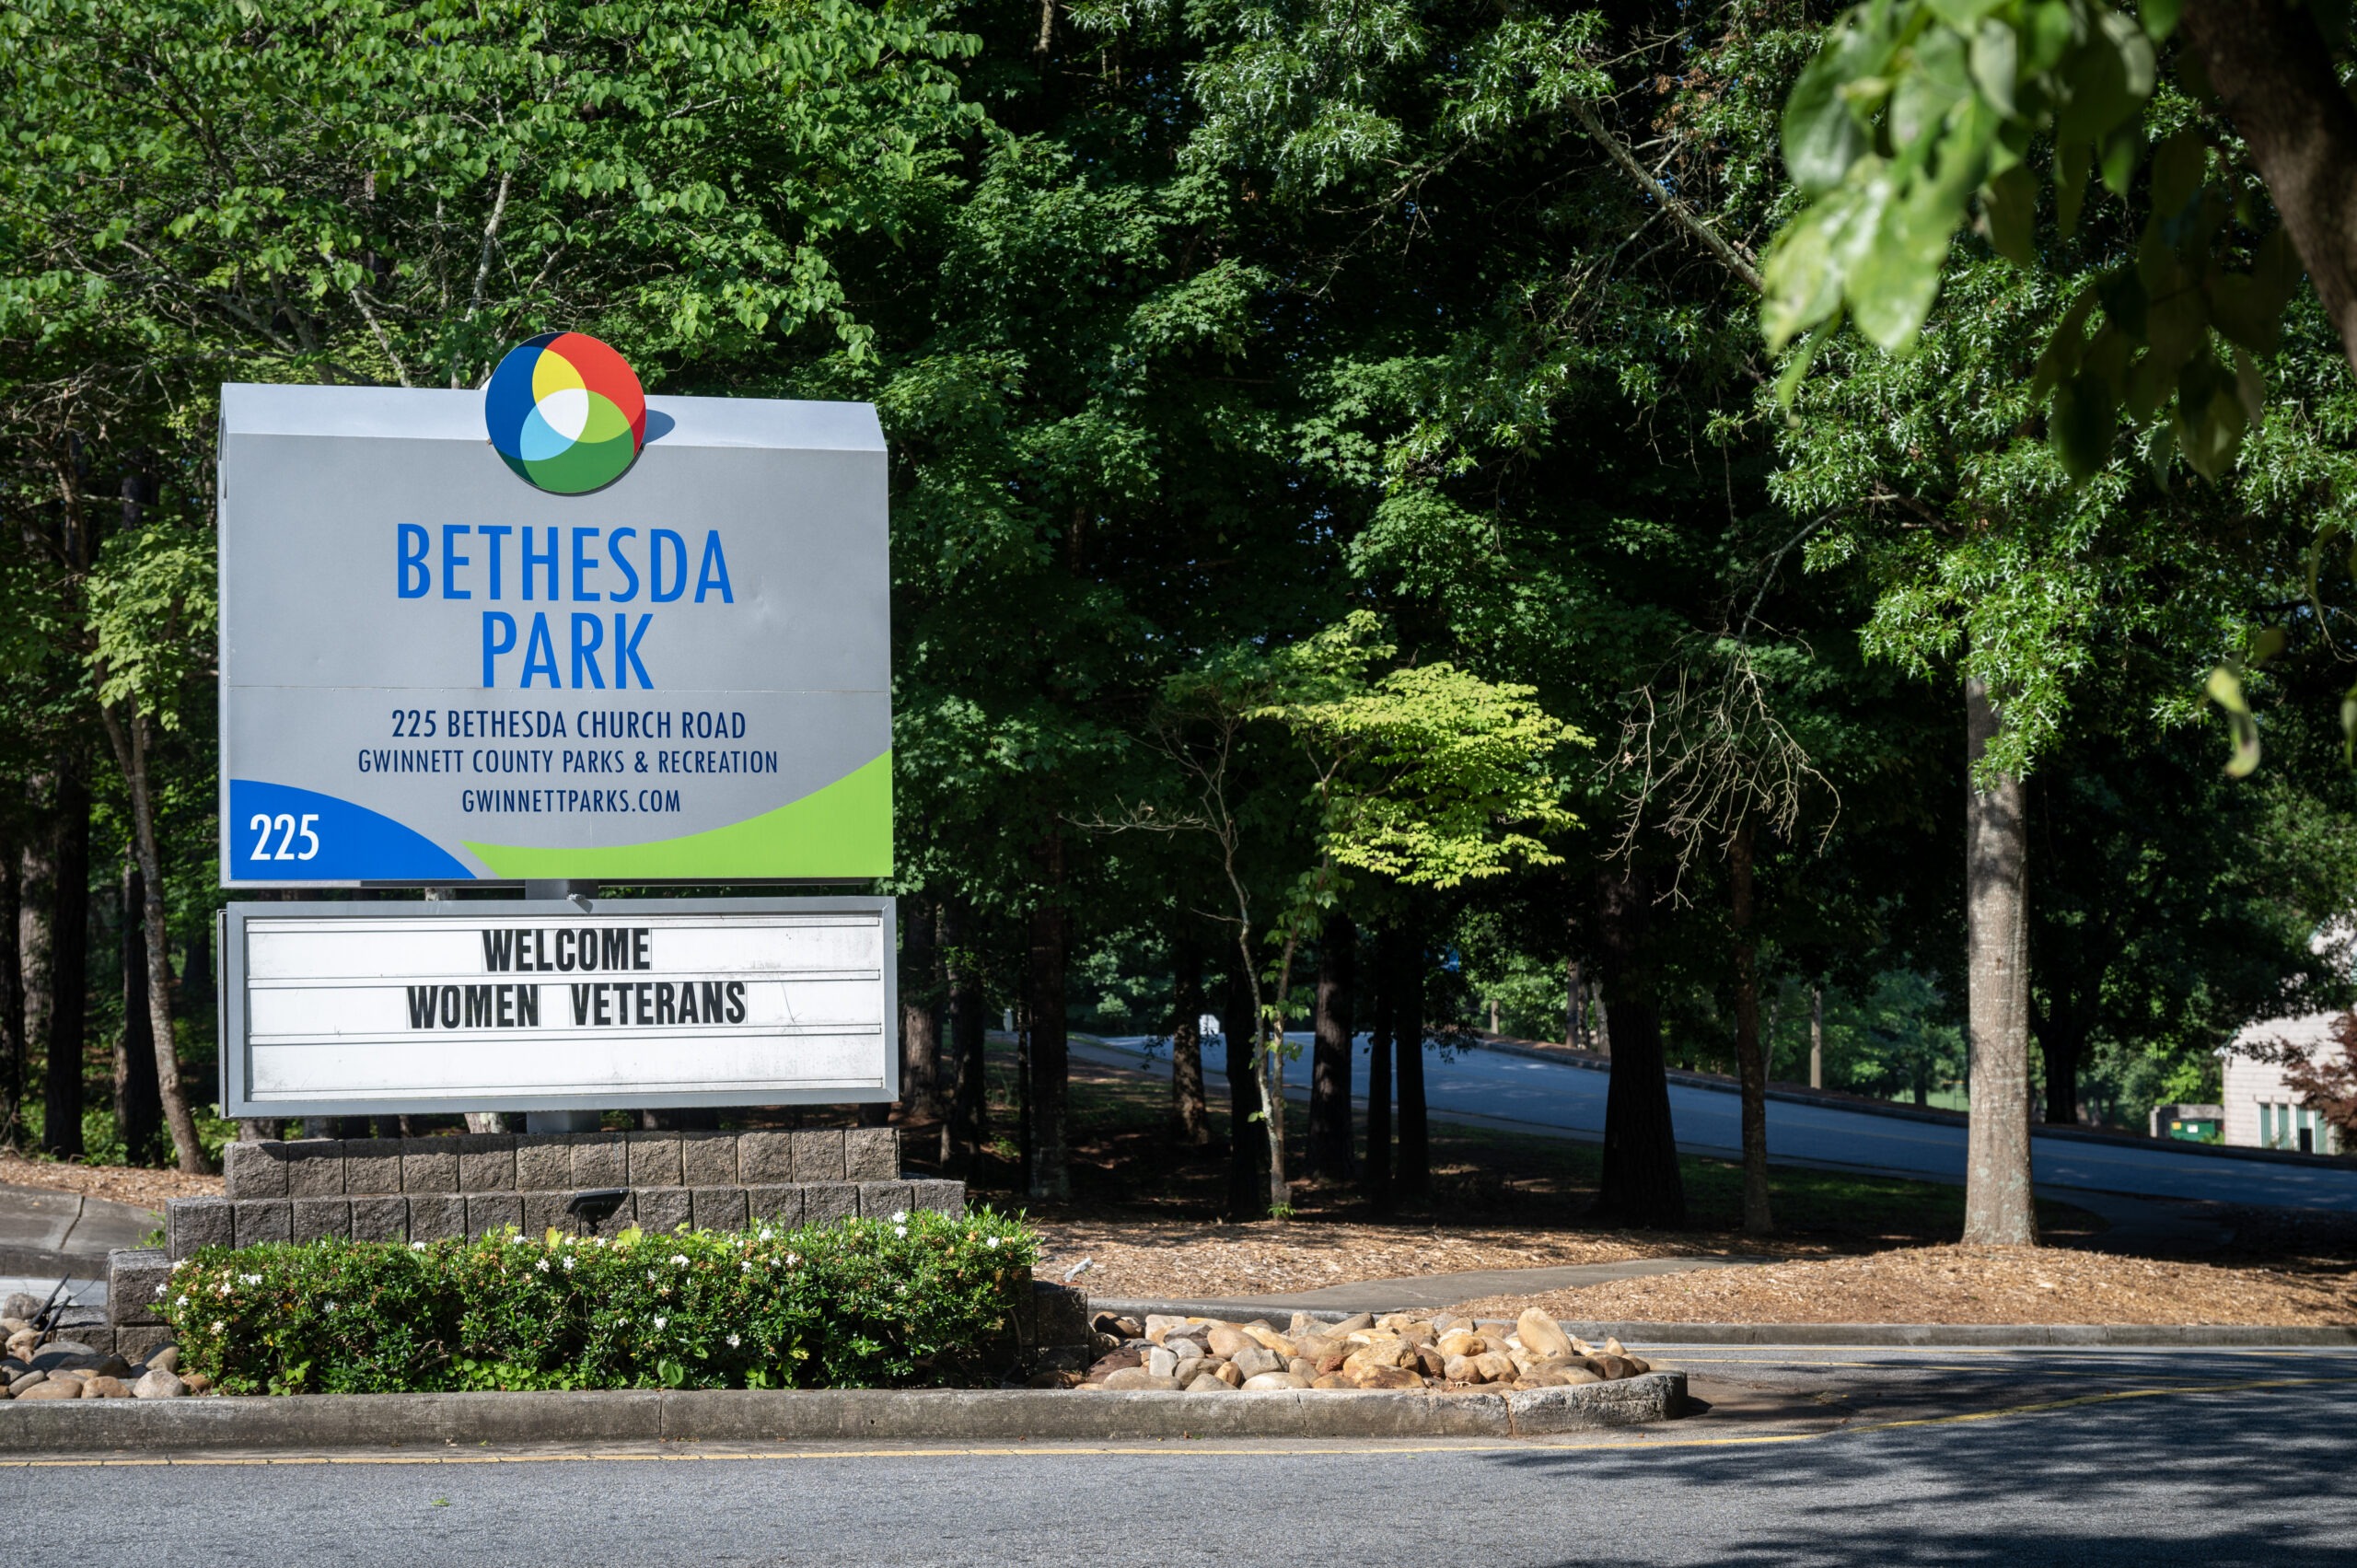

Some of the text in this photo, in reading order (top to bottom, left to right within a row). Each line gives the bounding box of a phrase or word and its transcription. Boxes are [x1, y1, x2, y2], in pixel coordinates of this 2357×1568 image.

[397, 523, 735, 604] BETHESDA
[482, 610, 655, 689] PARK
[391, 709, 746, 739] 225 BETHESDA CHURCH ROAD
[358, 749, 778, 773] GWINNETT COUNTY PARKS & RECREATION
[462, 789, 680, 813] GWINNETTPARKS.COM
[250, 813, 319, 861] 225
[482, 927, 649, 971] WELCOME
[407, 981, 746, 1028] WOMEN VETERANS
